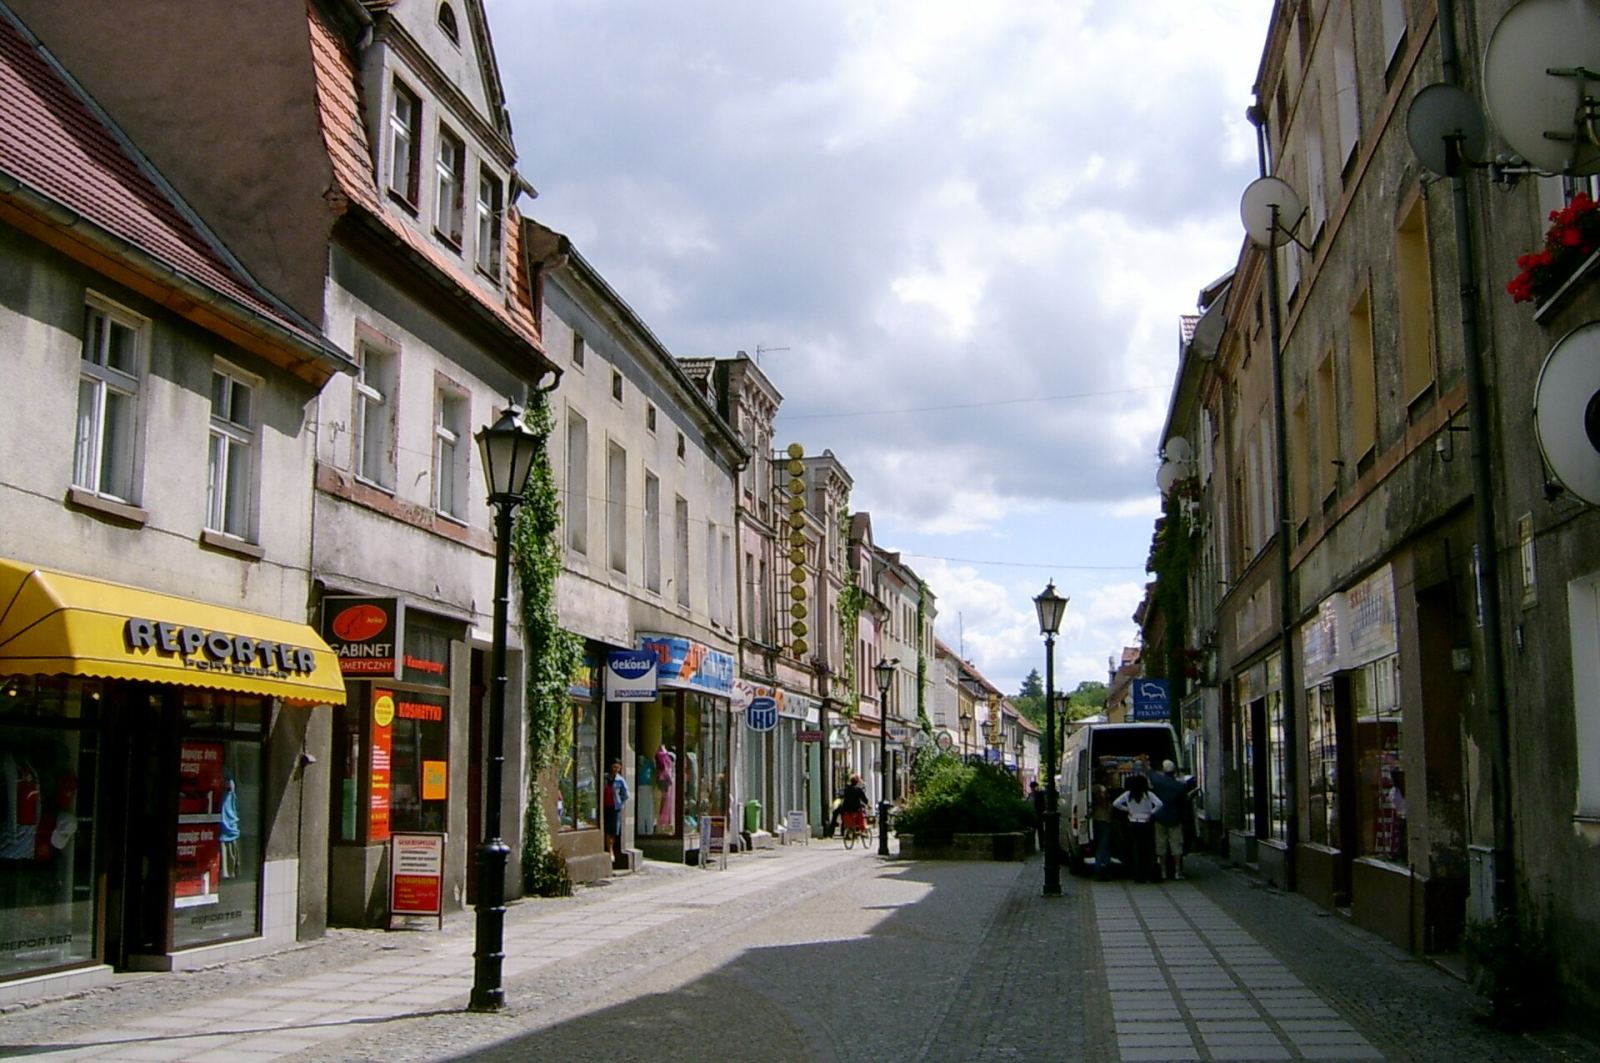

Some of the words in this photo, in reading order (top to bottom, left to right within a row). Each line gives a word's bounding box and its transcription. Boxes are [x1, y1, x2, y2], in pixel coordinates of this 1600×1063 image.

[124, 617, 317, 673] REPORTER
[330, 644, 392, 657] GABINET
[612, 658, 650, 670] dekoral
[399, 702, 442, 720] KOSMETYKI
[191, 910, 242, 925] REPORTER
